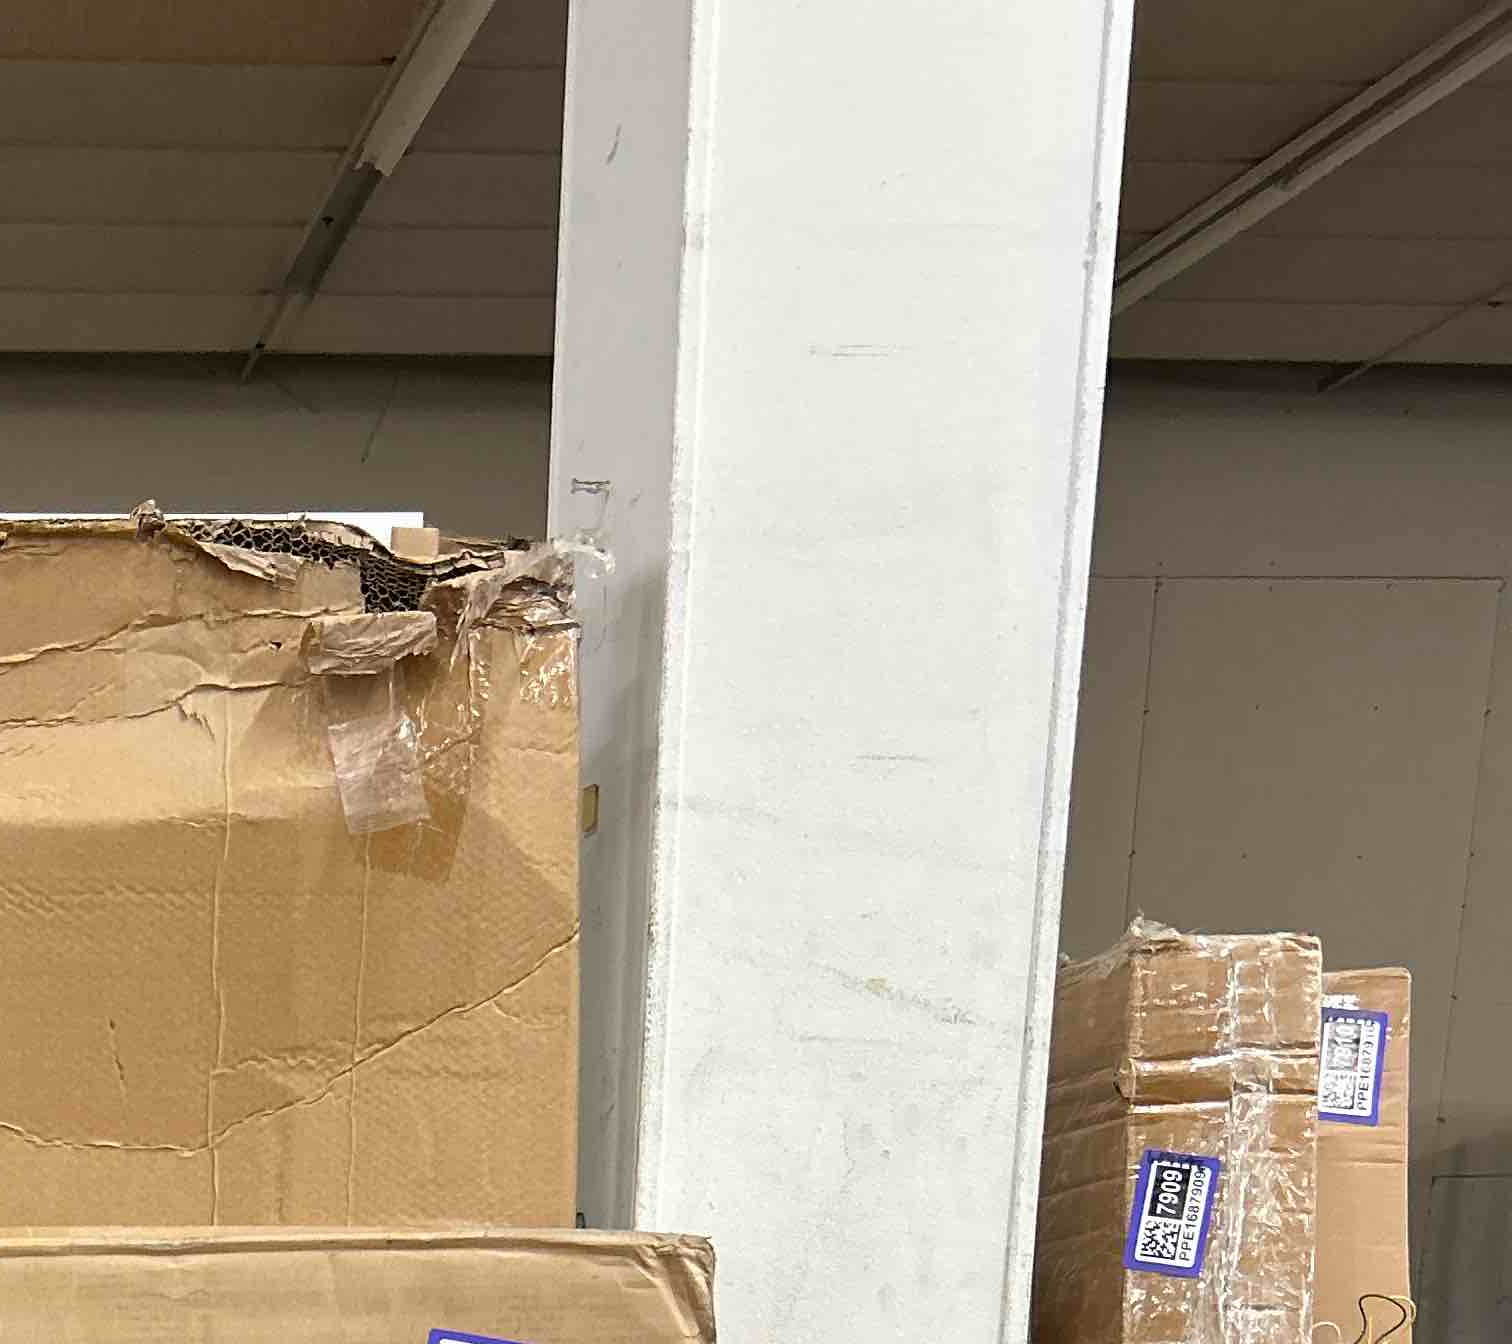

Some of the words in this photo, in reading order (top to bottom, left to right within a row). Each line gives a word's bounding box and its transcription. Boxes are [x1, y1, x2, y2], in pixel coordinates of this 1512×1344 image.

[1332, 1023, 1358, 1068] 7910
[1156, 1169, 1183, 1215] 7909
[1178, 1168, 1206, 1262] PPE1687909
